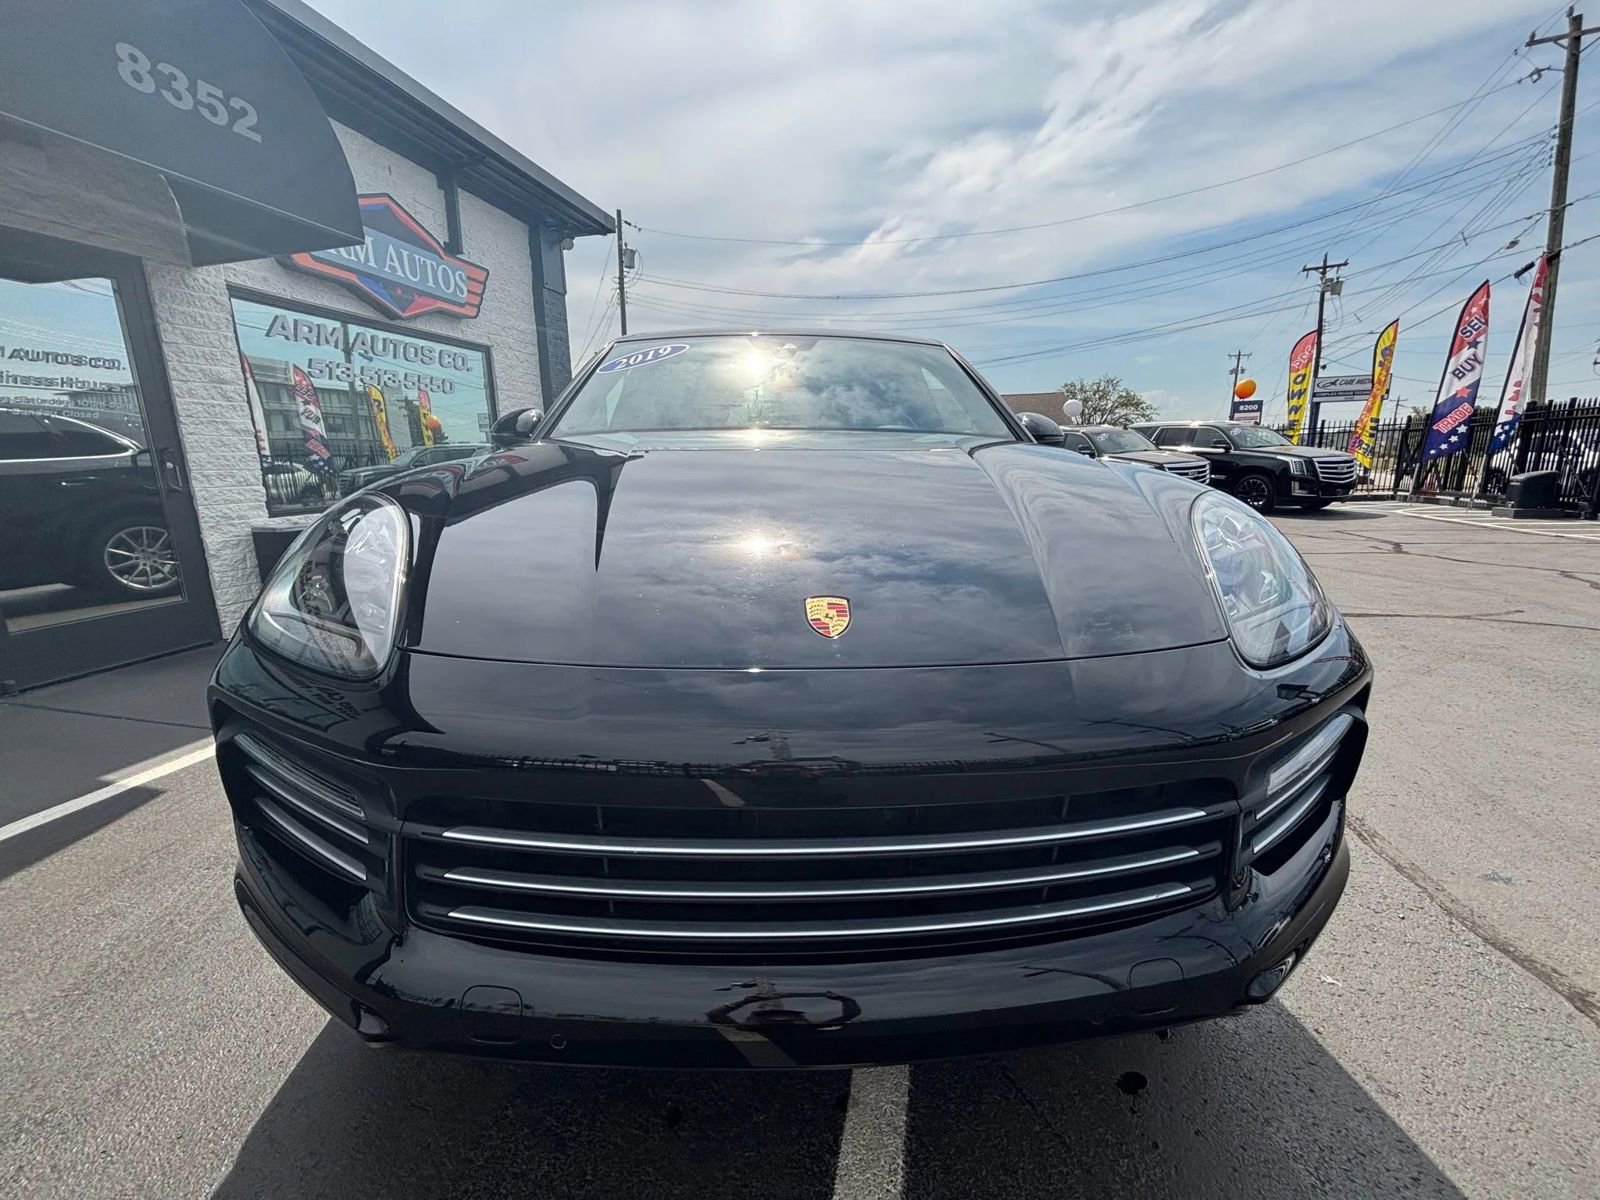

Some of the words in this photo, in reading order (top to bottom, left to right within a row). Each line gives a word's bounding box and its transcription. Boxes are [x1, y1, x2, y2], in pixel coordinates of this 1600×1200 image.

[115, 41, 262, 144] 8352
[384, 244, 468, 298] AUTOS
[265, 314, 344, 349] ARM
[351, 331, 436, 366] AUTOS
[439, 349, 473, 372] CO.
[614, 346, 672, 370] 2019
[1451, 353, 1483, 380] BUY
[1433, 402, 1474, 433] TRADE
